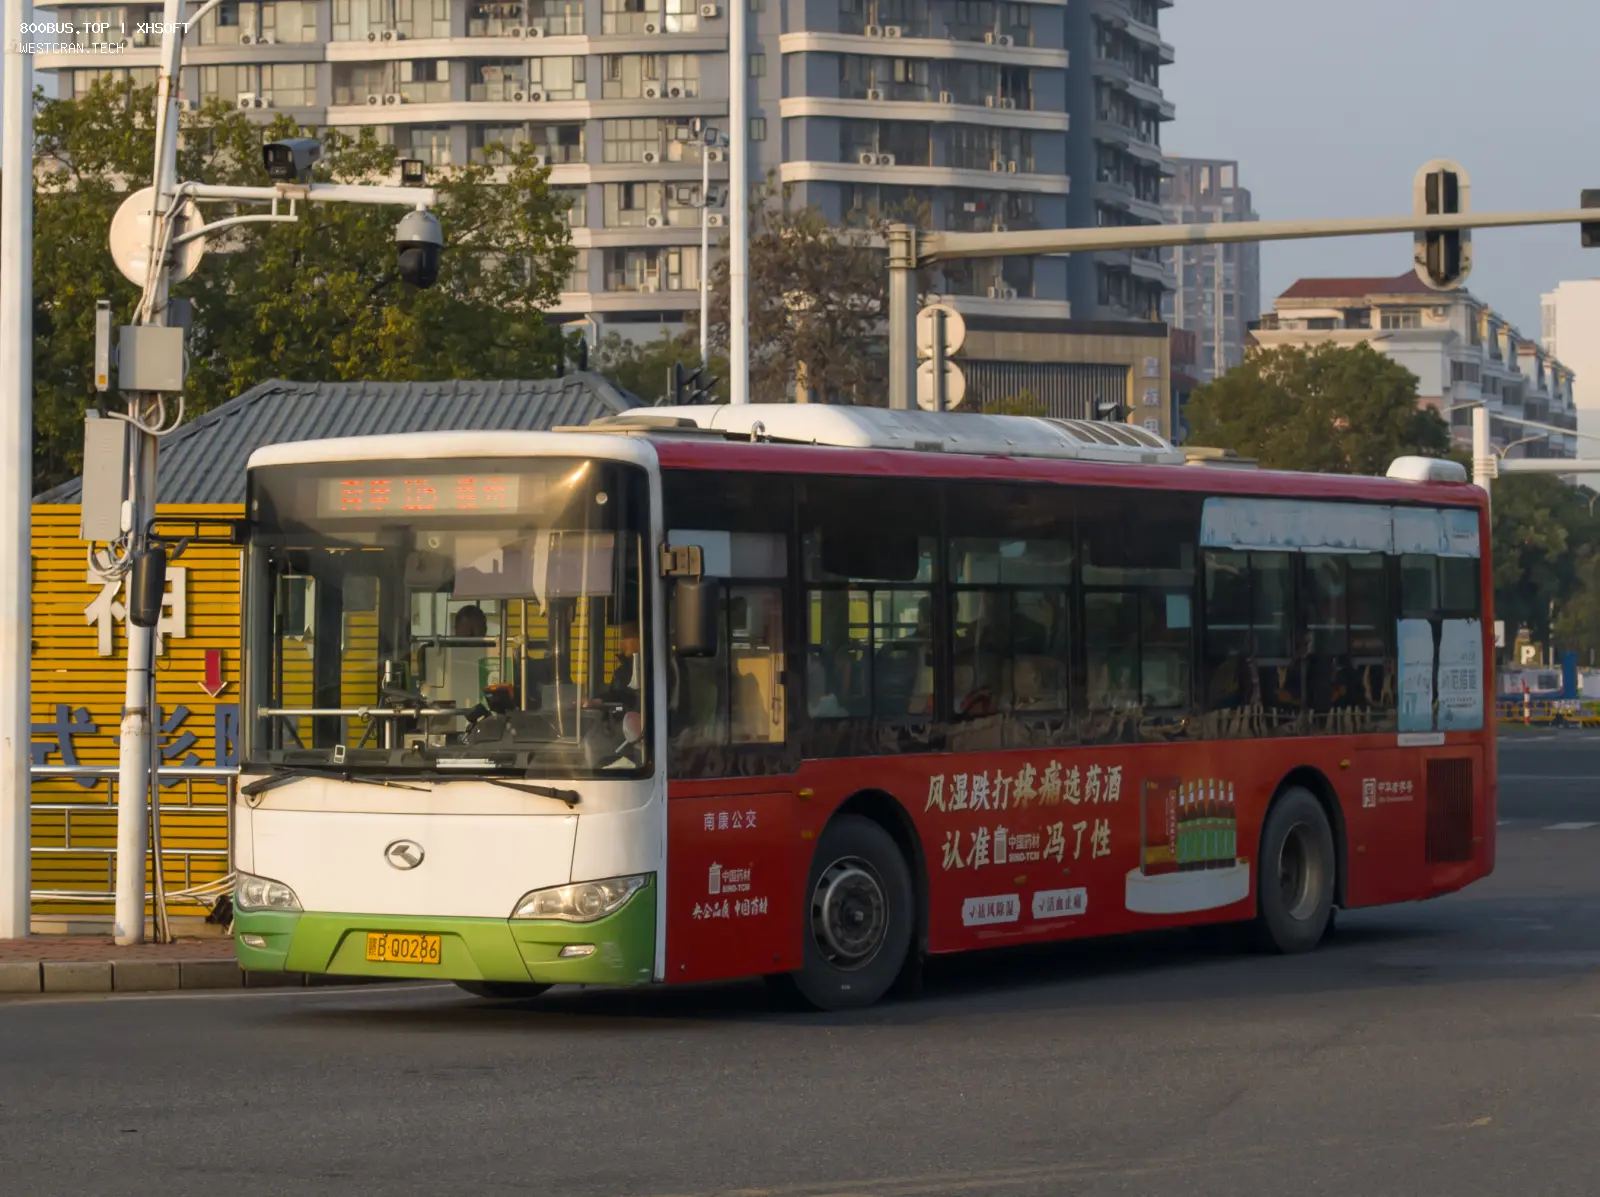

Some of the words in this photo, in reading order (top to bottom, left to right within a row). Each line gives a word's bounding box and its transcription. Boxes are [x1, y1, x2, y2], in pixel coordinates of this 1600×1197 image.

[923, 759, 1123, 814] 风湿跌打疼痛选药酒
[704, 809, 757, 831] 南康公交
[941, 826, 992, 872] 认准
[1042, 817, 1112, 864] 冯了性
